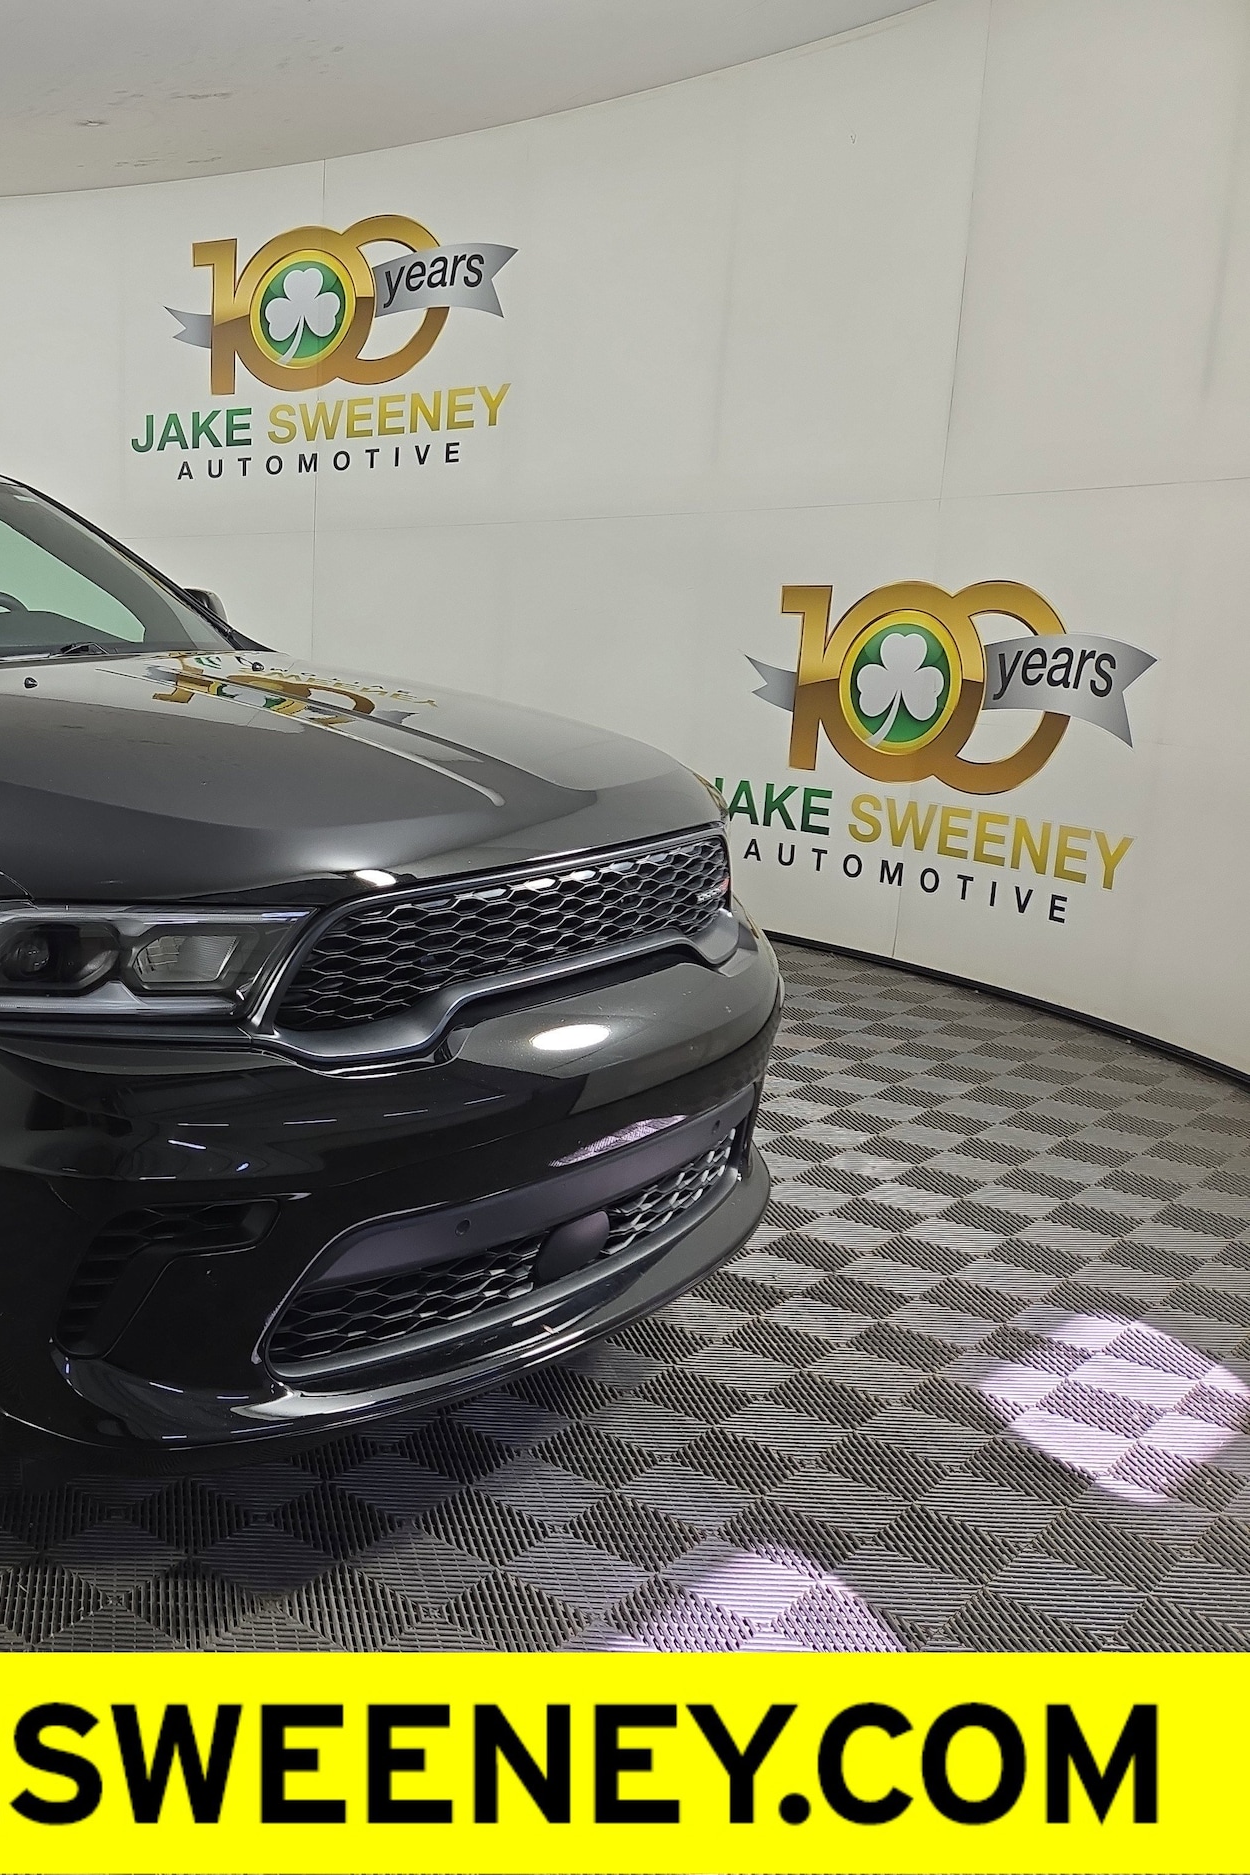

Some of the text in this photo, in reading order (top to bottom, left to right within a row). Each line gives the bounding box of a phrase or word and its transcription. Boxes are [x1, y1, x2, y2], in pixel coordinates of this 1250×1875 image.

[383, 252, 485, 308] years
[131, 383, 512, 453] JAKE SWEENEY
[177, 441, 462, 480] AUTOMOTIVE
[993, 646, 1117, 699] years
[848, 793, 1135, 891] SWEENEY
[743, 838, 1068, 923] AUTOMOTIVE
